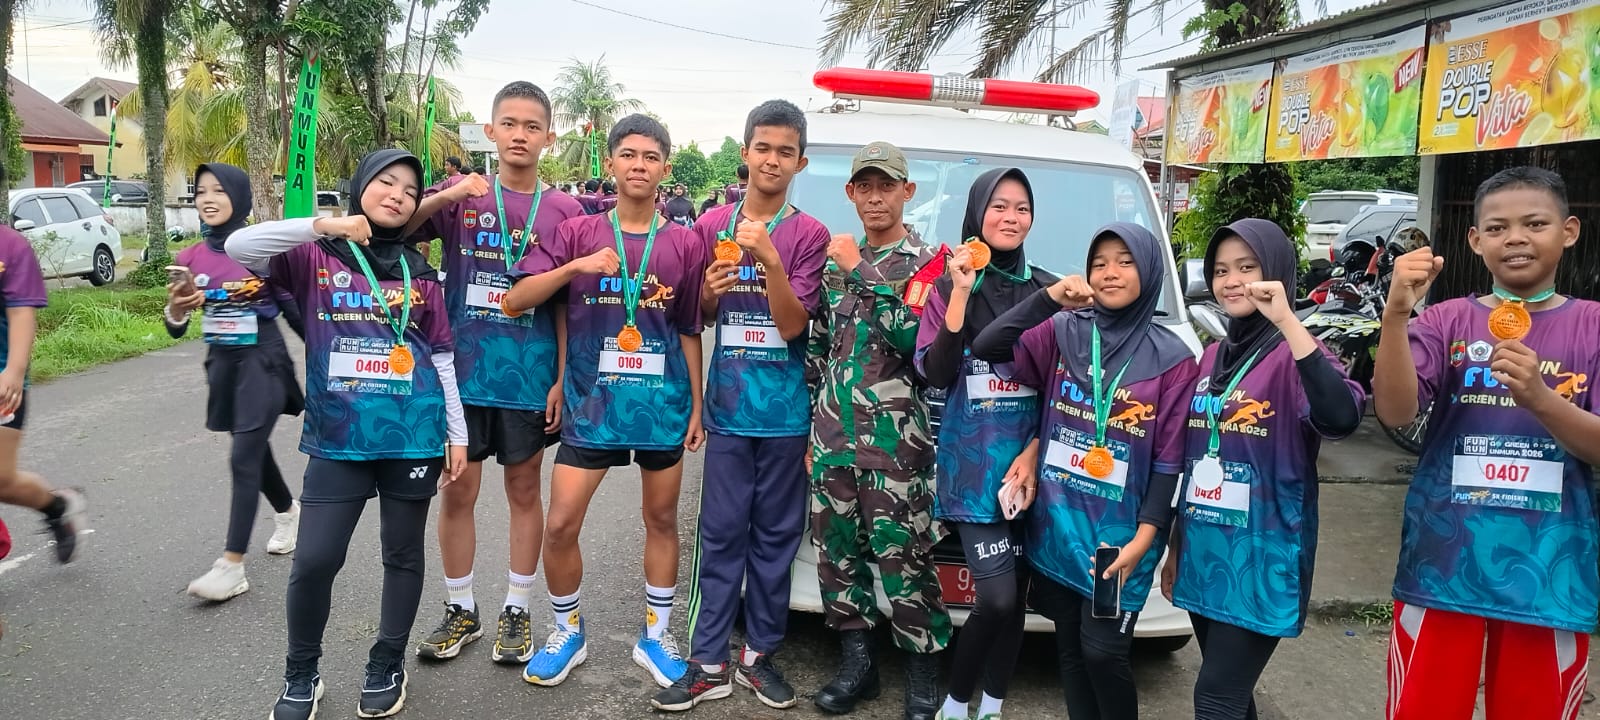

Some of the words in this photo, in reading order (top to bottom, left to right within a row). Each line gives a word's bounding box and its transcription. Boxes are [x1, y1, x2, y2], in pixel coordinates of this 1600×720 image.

[1457, 39, 1488, 63] ESSE
[1398, 51, 1421, 87] NEW
[1442, 60, 1494, 88] DOUBLE
[1281, 92, 1312, 111] DOUBLE
[1437, 82, 1492, 120] POP
[1278, 108, 1311, 136] POP
[1476, 84, 1533, 147] Vita
[292, 71, 316, 190] UNMURA
[1300, 110, 1336, 157] Vita
[475, 250, 498, 260] GREEN
[598, 296, 622, 305] GREEN
[332, 312, 362, 322] GREEN
[745, 330, 765, 343] 0112
[356, 359, 389, 374] 0409
[618, 356, 643, 369] 0109
[989, 378, 1020, 392] 0429
[1460, 394, 1496, 405] GREEN
[1055, 401, 1081, 417] GREEN
[1465, 437, 1486, 446] FUN
[1465, 445, 1486, 453] RUN
[1504, 441, 1530, 449] GREEN
[1489, 448, 1520, 457] UNMURA
[1521, 448, 1544, 458] 2026
[1485, 463, 1530, 483] 0407
[1195, 485, 1222, 501] 0428
[1501, 494, 1528, 502] FINISHER
[974, 536, 1010, 561] Lost
